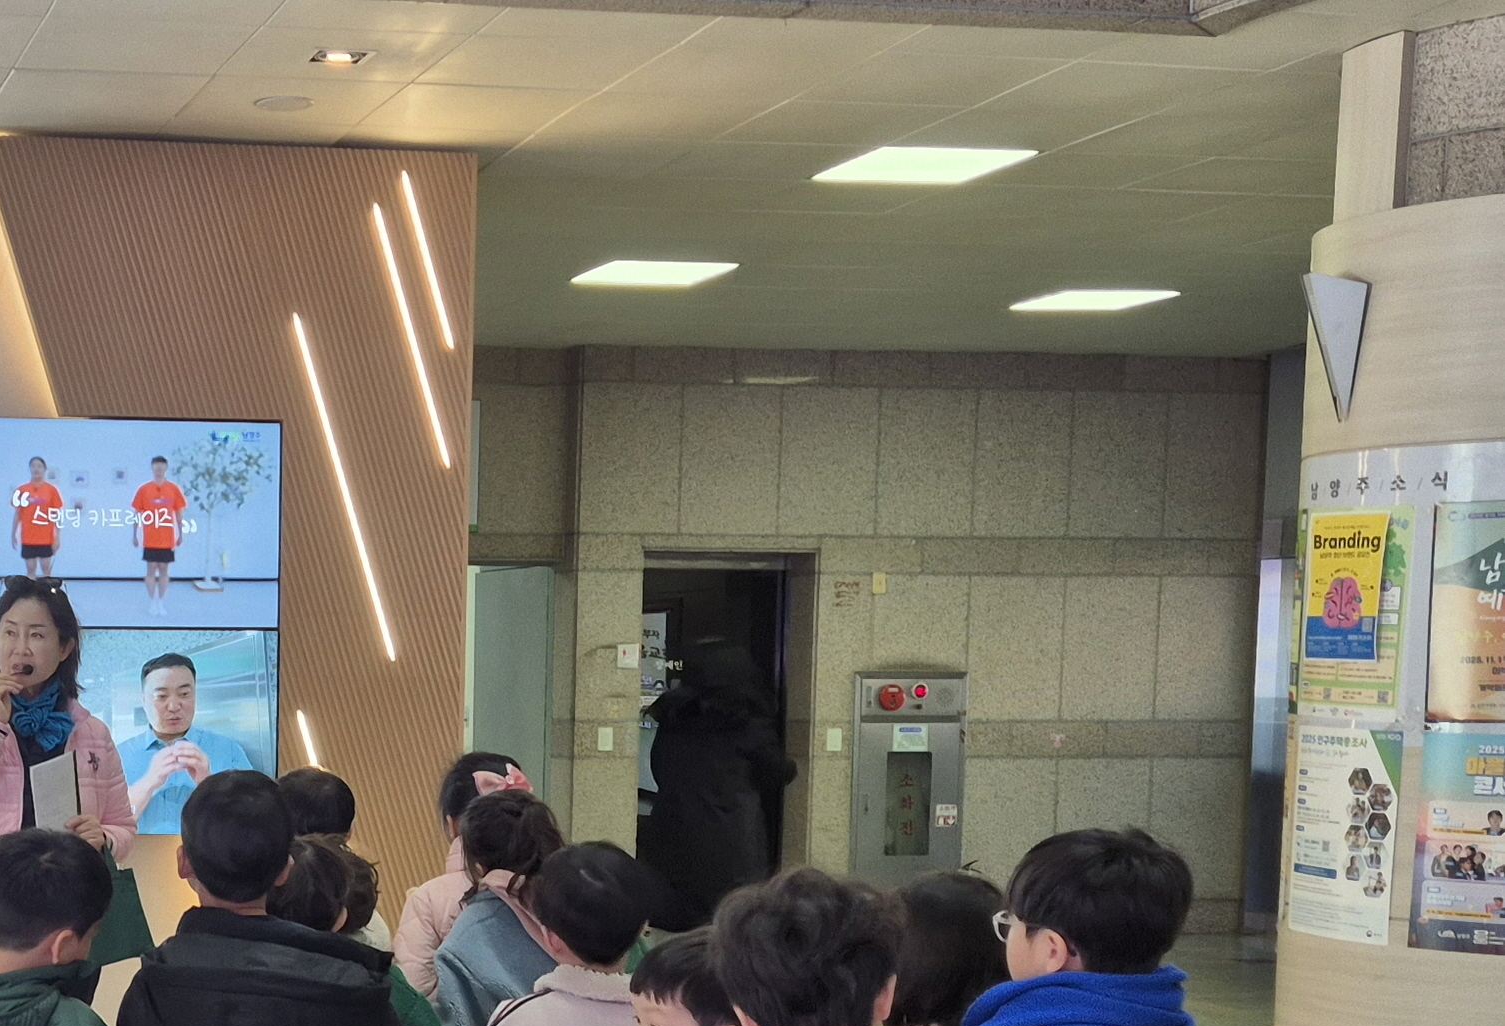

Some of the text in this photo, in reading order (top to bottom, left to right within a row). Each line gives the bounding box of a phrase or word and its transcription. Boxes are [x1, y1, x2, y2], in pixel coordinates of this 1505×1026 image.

[88, 507, 174, 529] 카프레이즈
[1313, 530, 1382, 553] Branding
[1478, 744, 1505, 755] 2025
